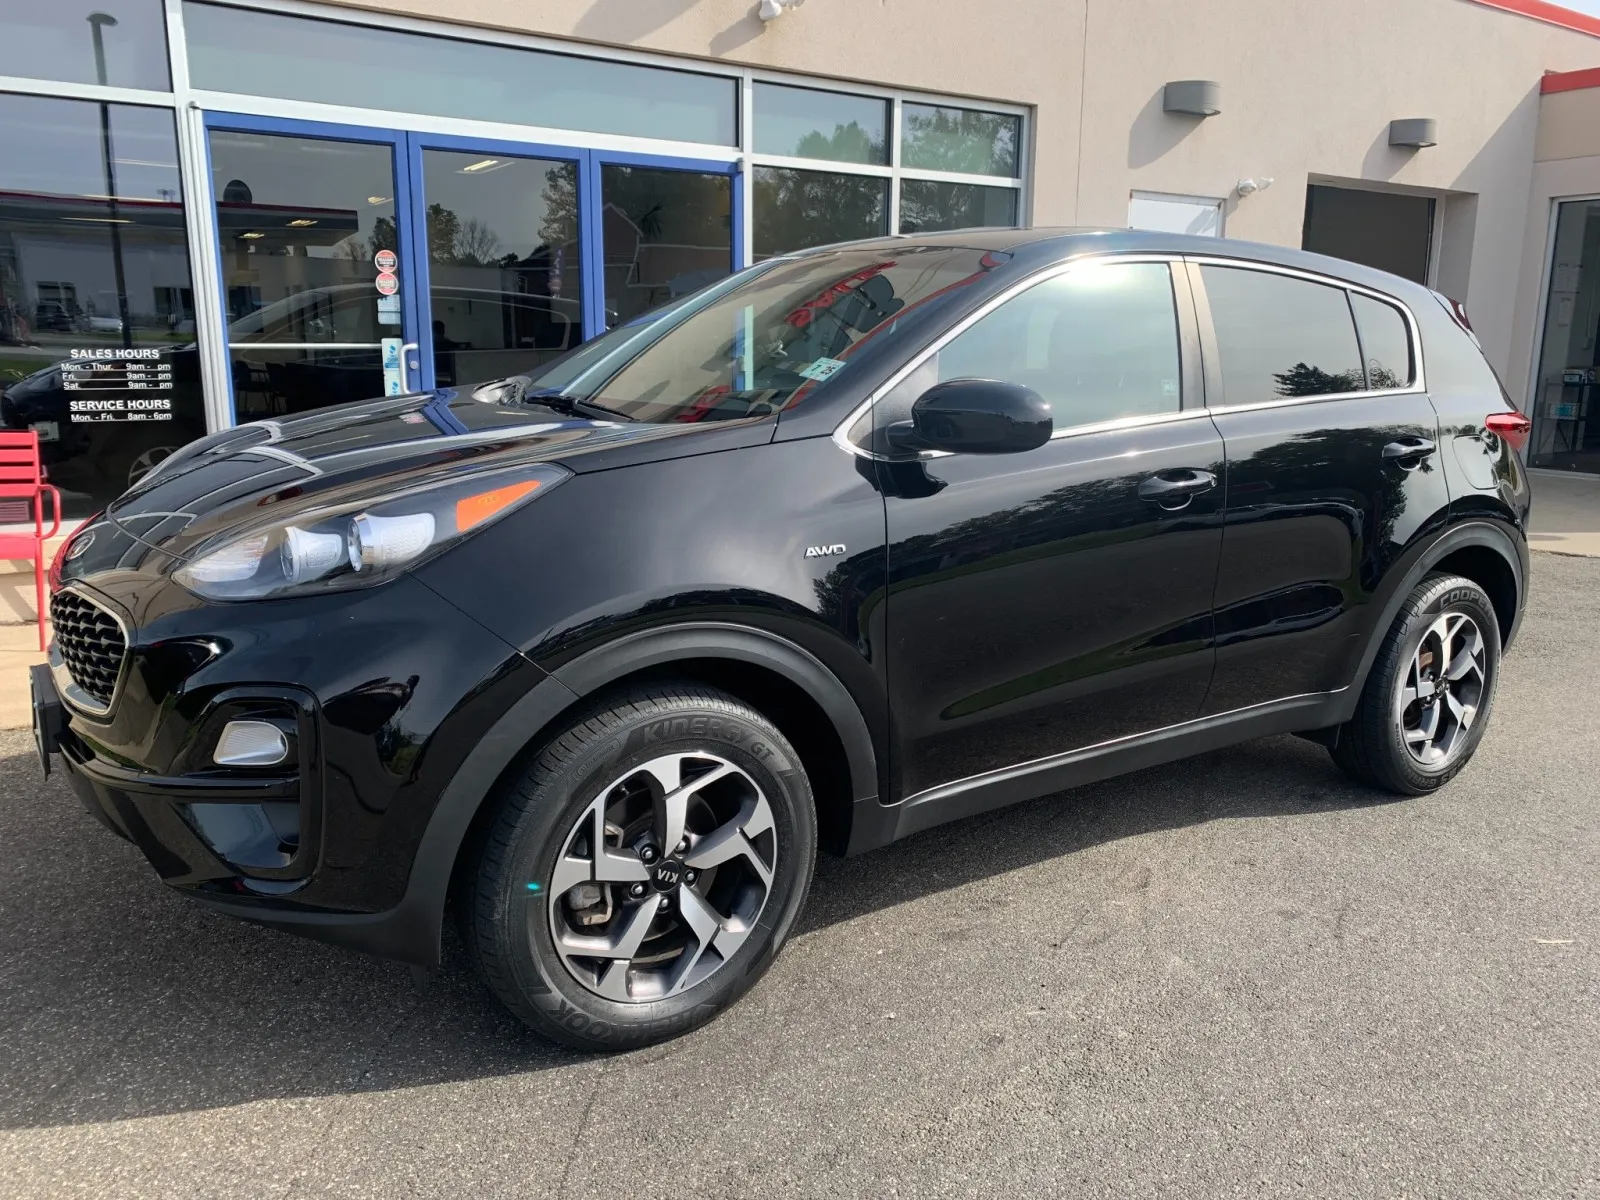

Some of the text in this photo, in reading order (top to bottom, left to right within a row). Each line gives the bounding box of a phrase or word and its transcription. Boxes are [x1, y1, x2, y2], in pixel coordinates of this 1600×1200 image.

[71, 349, 159, 359] SALES HOURS
[91, 362, 114, 370] Thur.
[127, 372, 145, 380] 9am
[63, 382, 81, 390] Sat.
[128, 381, 147, 389] 9am
[70, 400, 171, 410] SERVICE HOURS
[154, 412, 172, 420] 6pm
[804, 544, 846, 558] AWD
[1440, 589, 1493, 618] COOPER
[749, 742, 775, 760] GT
[657, 868, 679, 884] KIA
